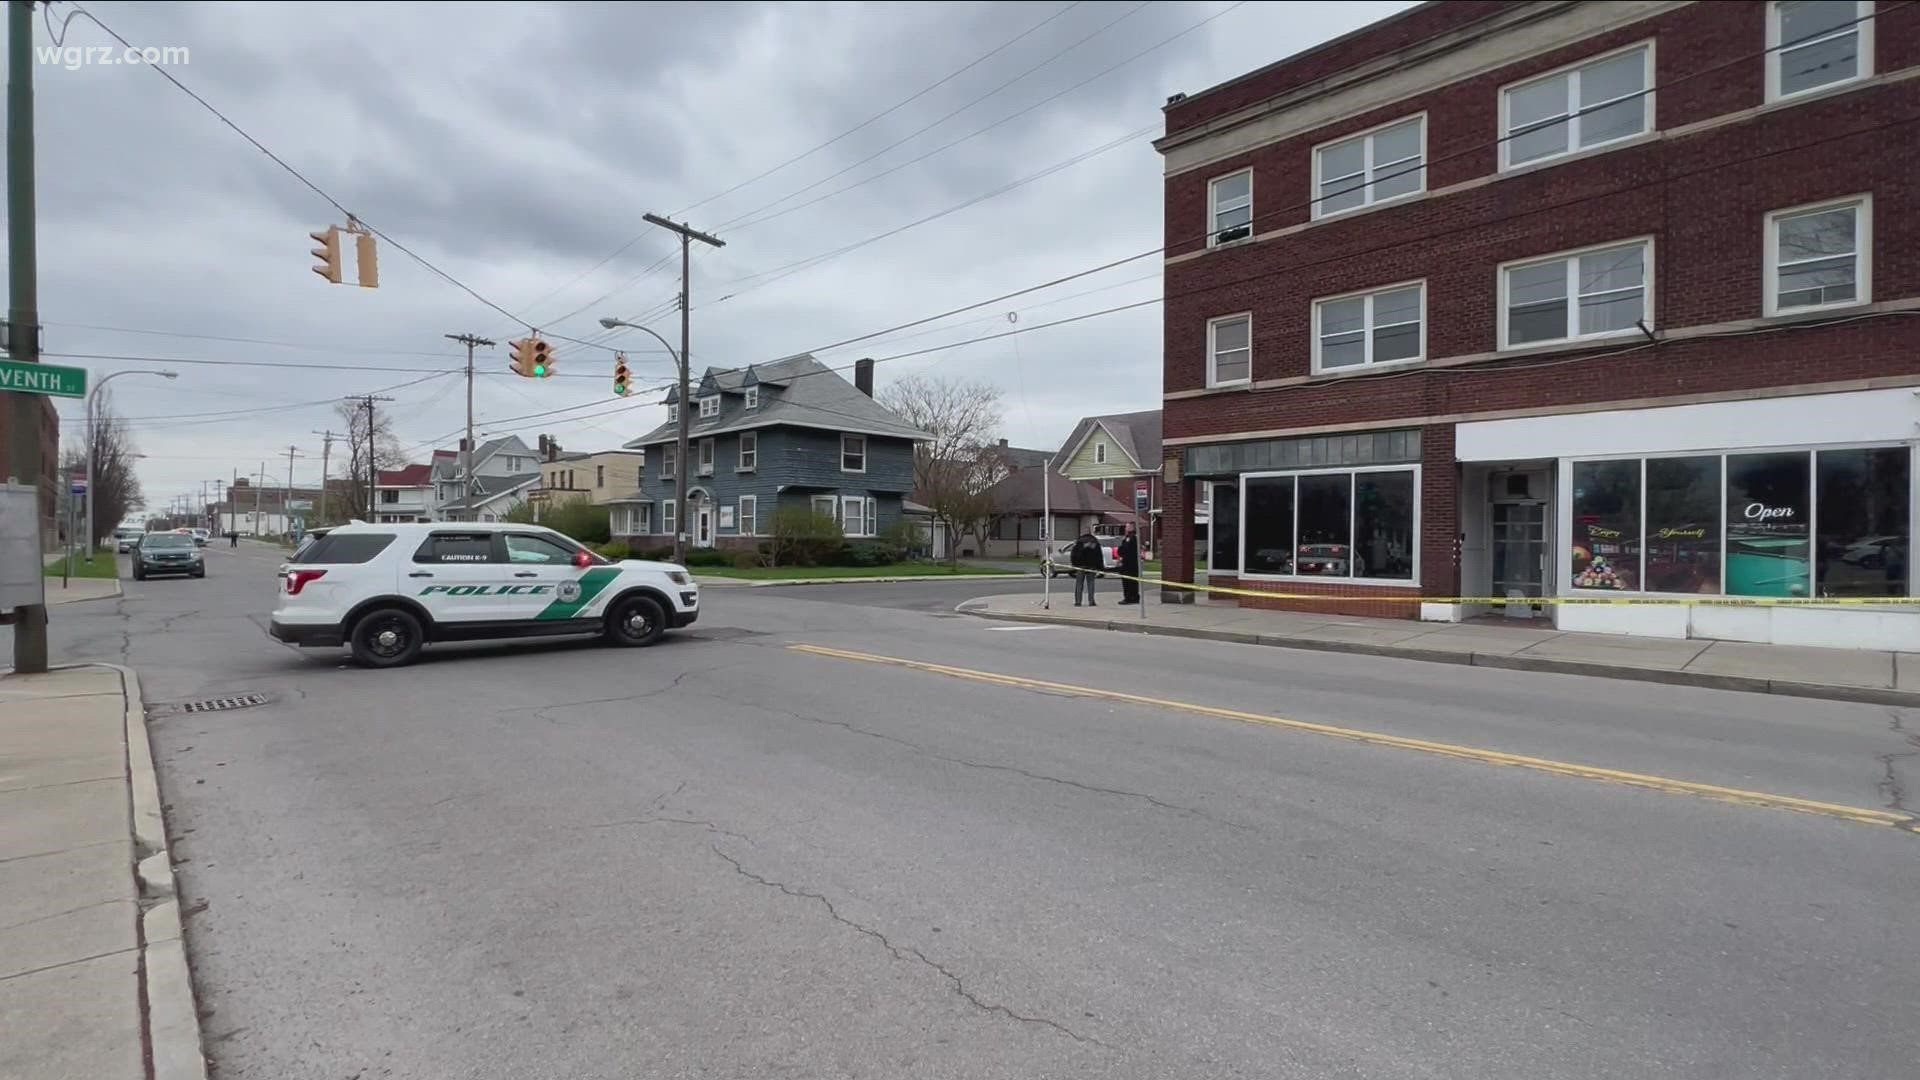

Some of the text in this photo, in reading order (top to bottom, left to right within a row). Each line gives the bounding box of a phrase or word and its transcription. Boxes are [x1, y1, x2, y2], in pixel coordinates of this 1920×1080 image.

[0, 367, 61, 391] VENTH
[1744, 502, 1795, 521] Open
[1587, 525, 1623, 537] Enjoy
[1659, 527, 1705, 539] Yourself
[418, 585, 556, 596] POLICE
